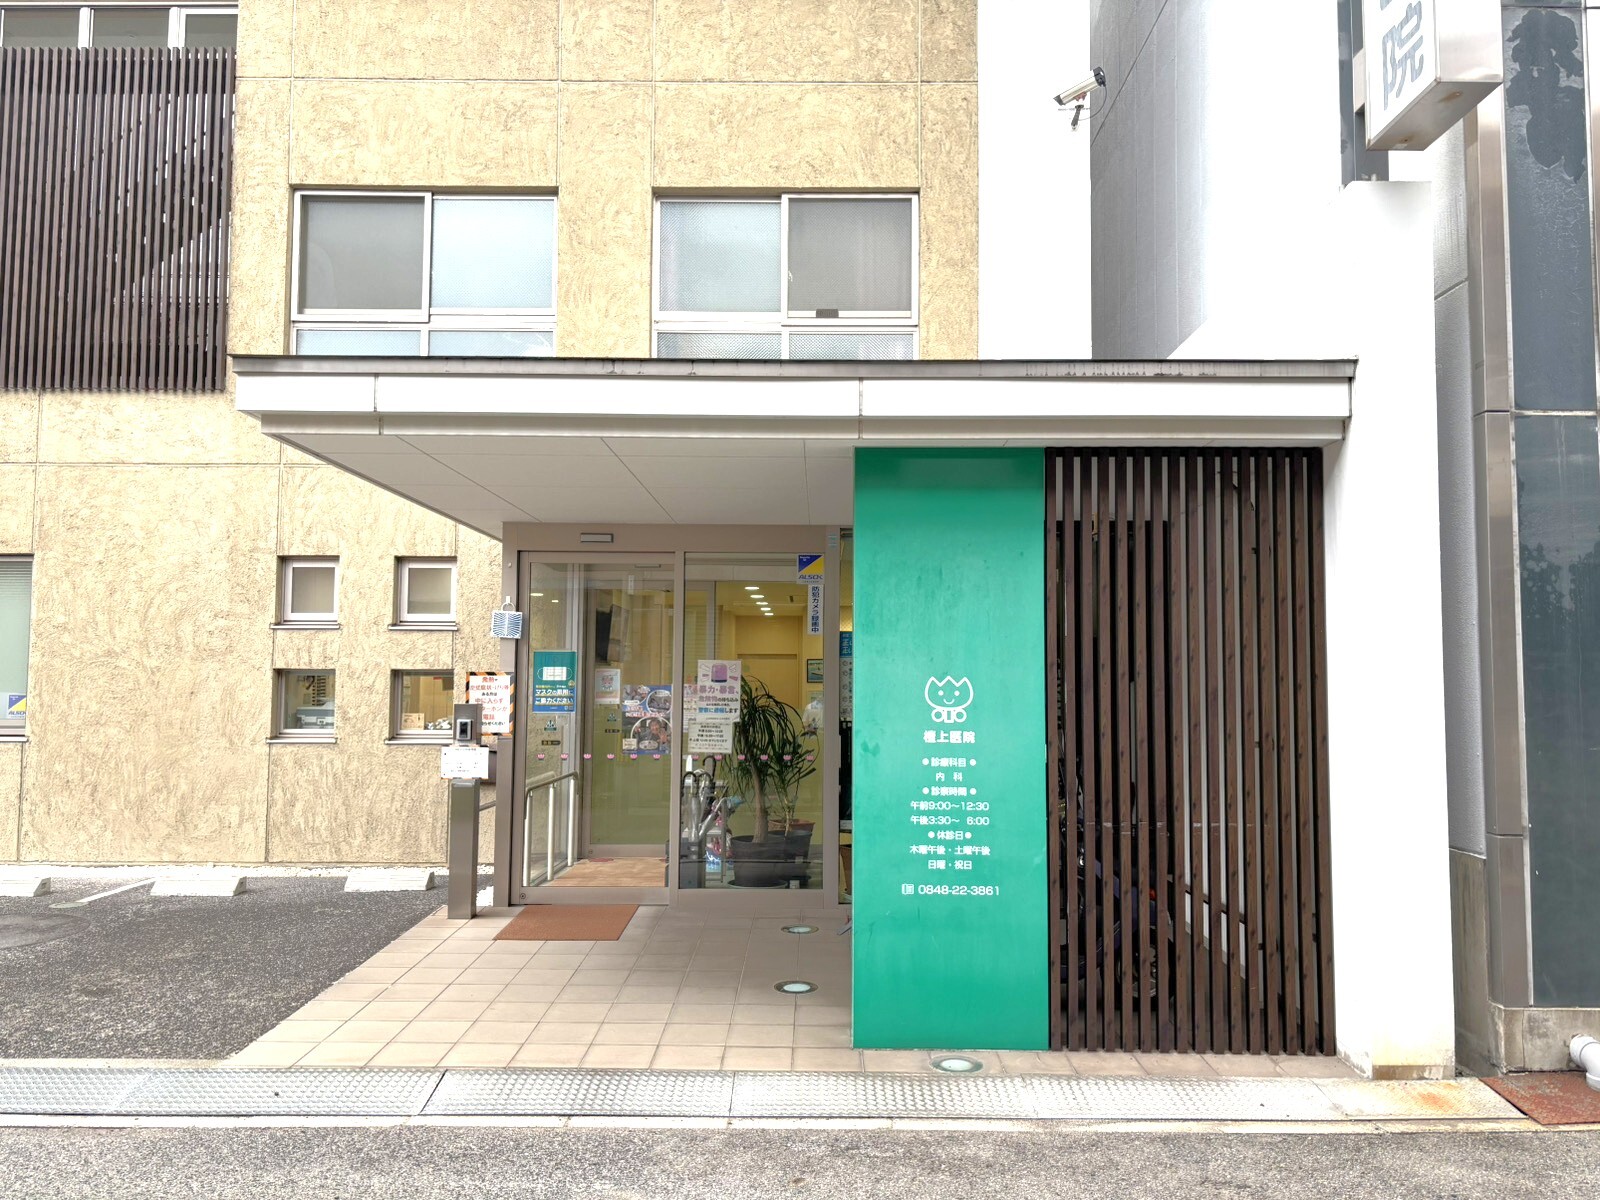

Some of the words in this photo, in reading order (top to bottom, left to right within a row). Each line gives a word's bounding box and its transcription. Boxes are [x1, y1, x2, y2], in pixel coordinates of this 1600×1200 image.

[1380, 0, 1425, 111] 院
[928, 859, 972, 870] 日曜・祝日
[917, 884, 1000, 896] 0848-22-3861
